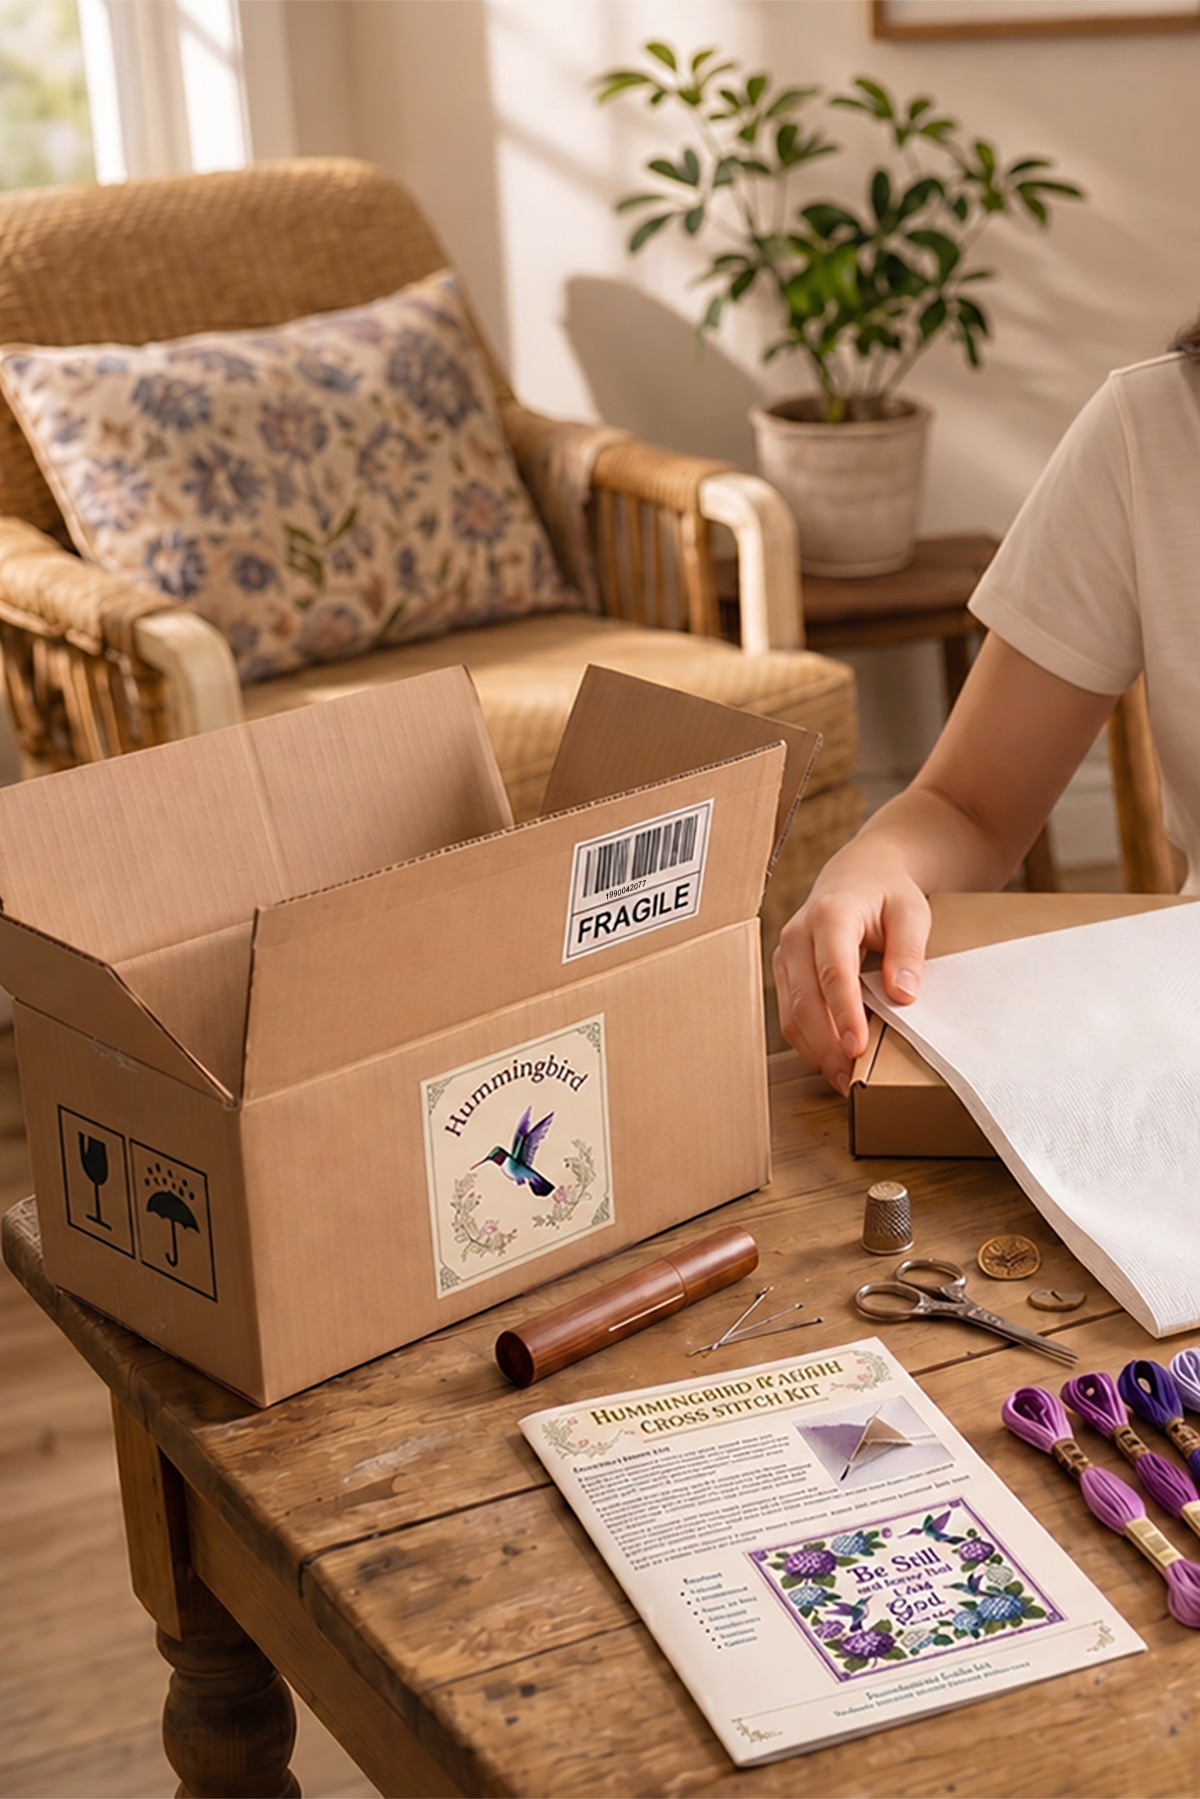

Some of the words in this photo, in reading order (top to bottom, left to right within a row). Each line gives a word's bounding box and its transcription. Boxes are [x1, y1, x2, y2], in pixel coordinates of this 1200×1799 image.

[605, 879, 647, 899] 1990042077
[577, 883, 690, 943] FRAGILE
[445, 1054, 589, 1137] Hummingbird
[590, 1381, 752, 1425] HUMMINGBIRD
[640, 1408, 710, 1434] CROSS
[711, 1392, 783, 1418] STITCH
[783, 1383, 820, 1402] KIT
[846, 1566, 888, 1583] Be
[891, 1547, 941, 1572] Still
